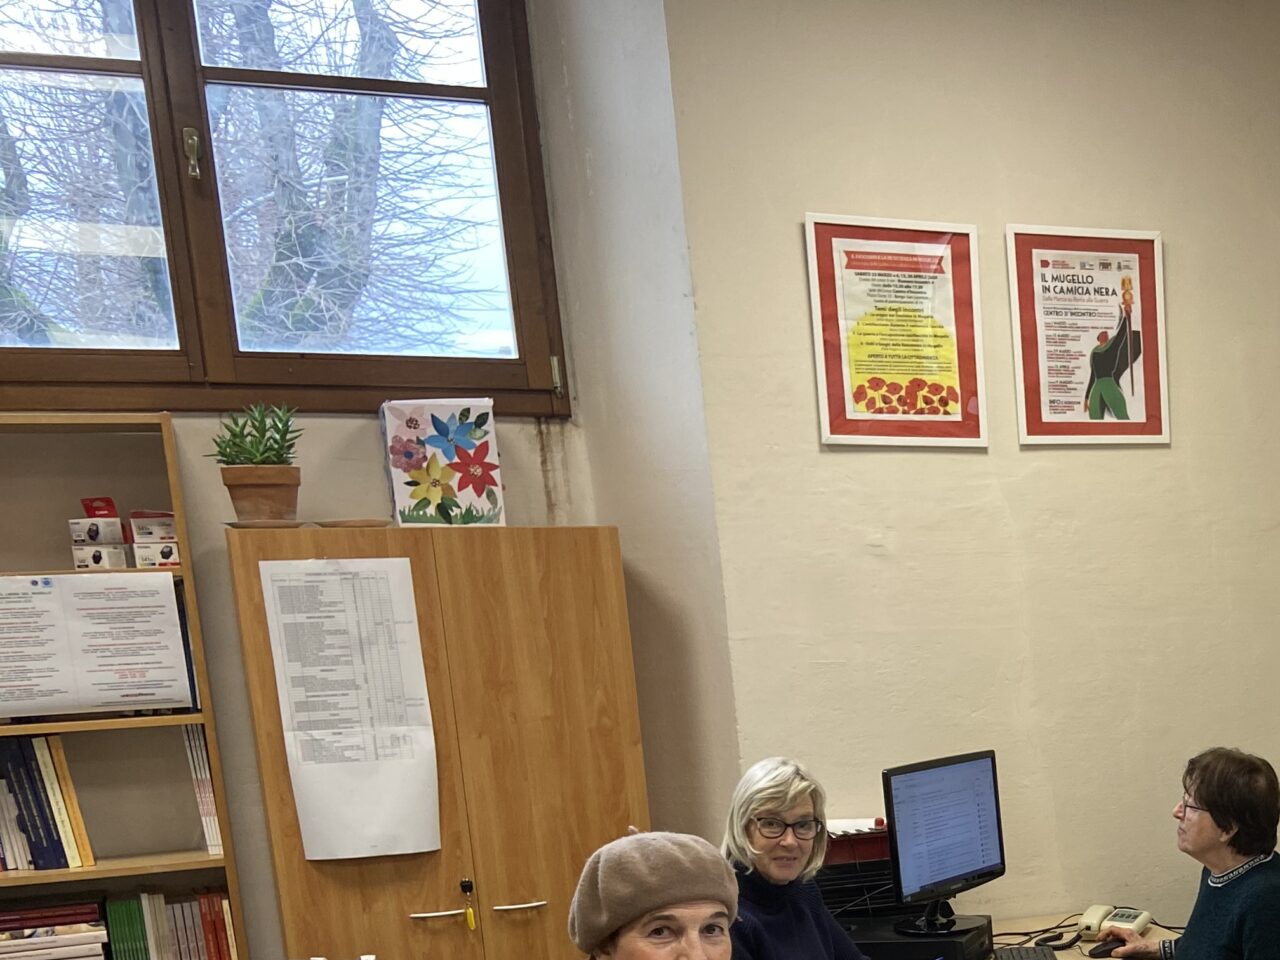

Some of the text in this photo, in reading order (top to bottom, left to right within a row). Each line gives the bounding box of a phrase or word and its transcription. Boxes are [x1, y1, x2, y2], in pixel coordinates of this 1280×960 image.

[1041, 273, 1094, 284] IL MUGELLO
[1042, 285, 1118, 296] IN CAMICIA NERA
